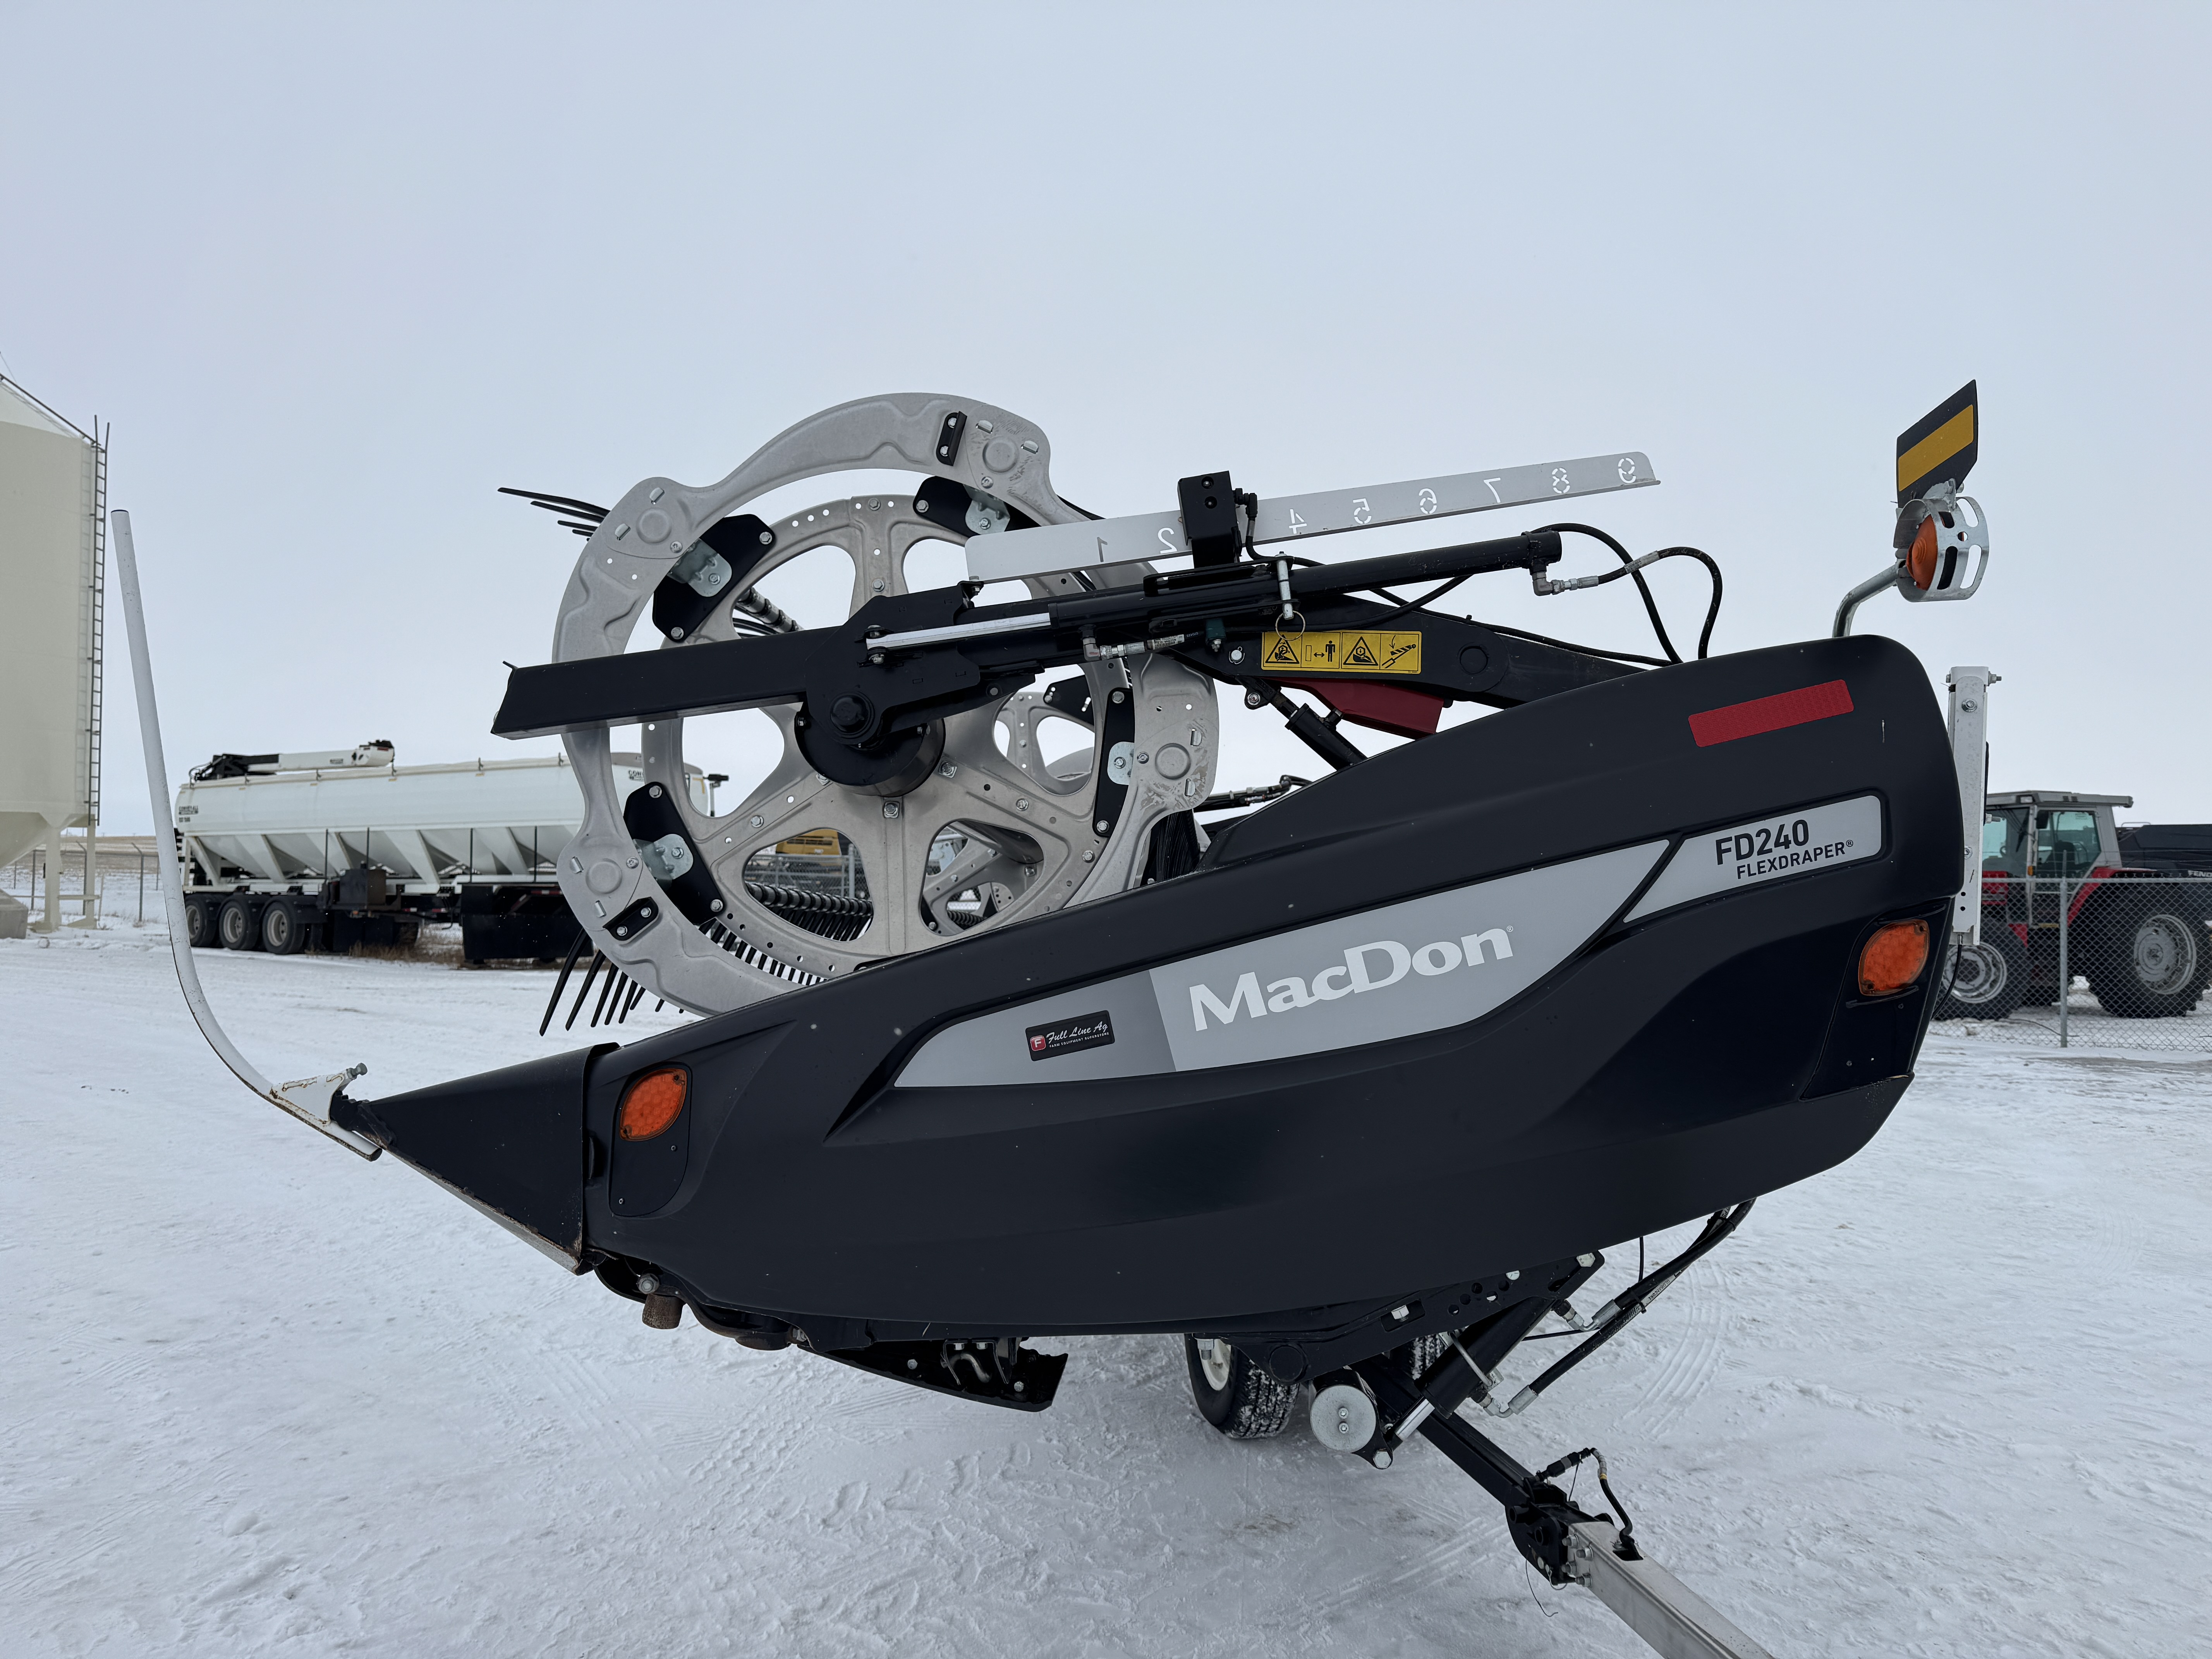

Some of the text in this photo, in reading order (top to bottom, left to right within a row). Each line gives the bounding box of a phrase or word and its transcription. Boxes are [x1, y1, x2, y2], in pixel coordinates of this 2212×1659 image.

[1716, 820, 1809, 865] FD240
[1737, 840, 1854, 879] FLEXDRAPER®
[1034, 1039, 1042, 1048] F
[1046, 1021, 1108, 1044] Full Line Ag
[1061, 1037, 1084, 1046] EQUIPMENT
